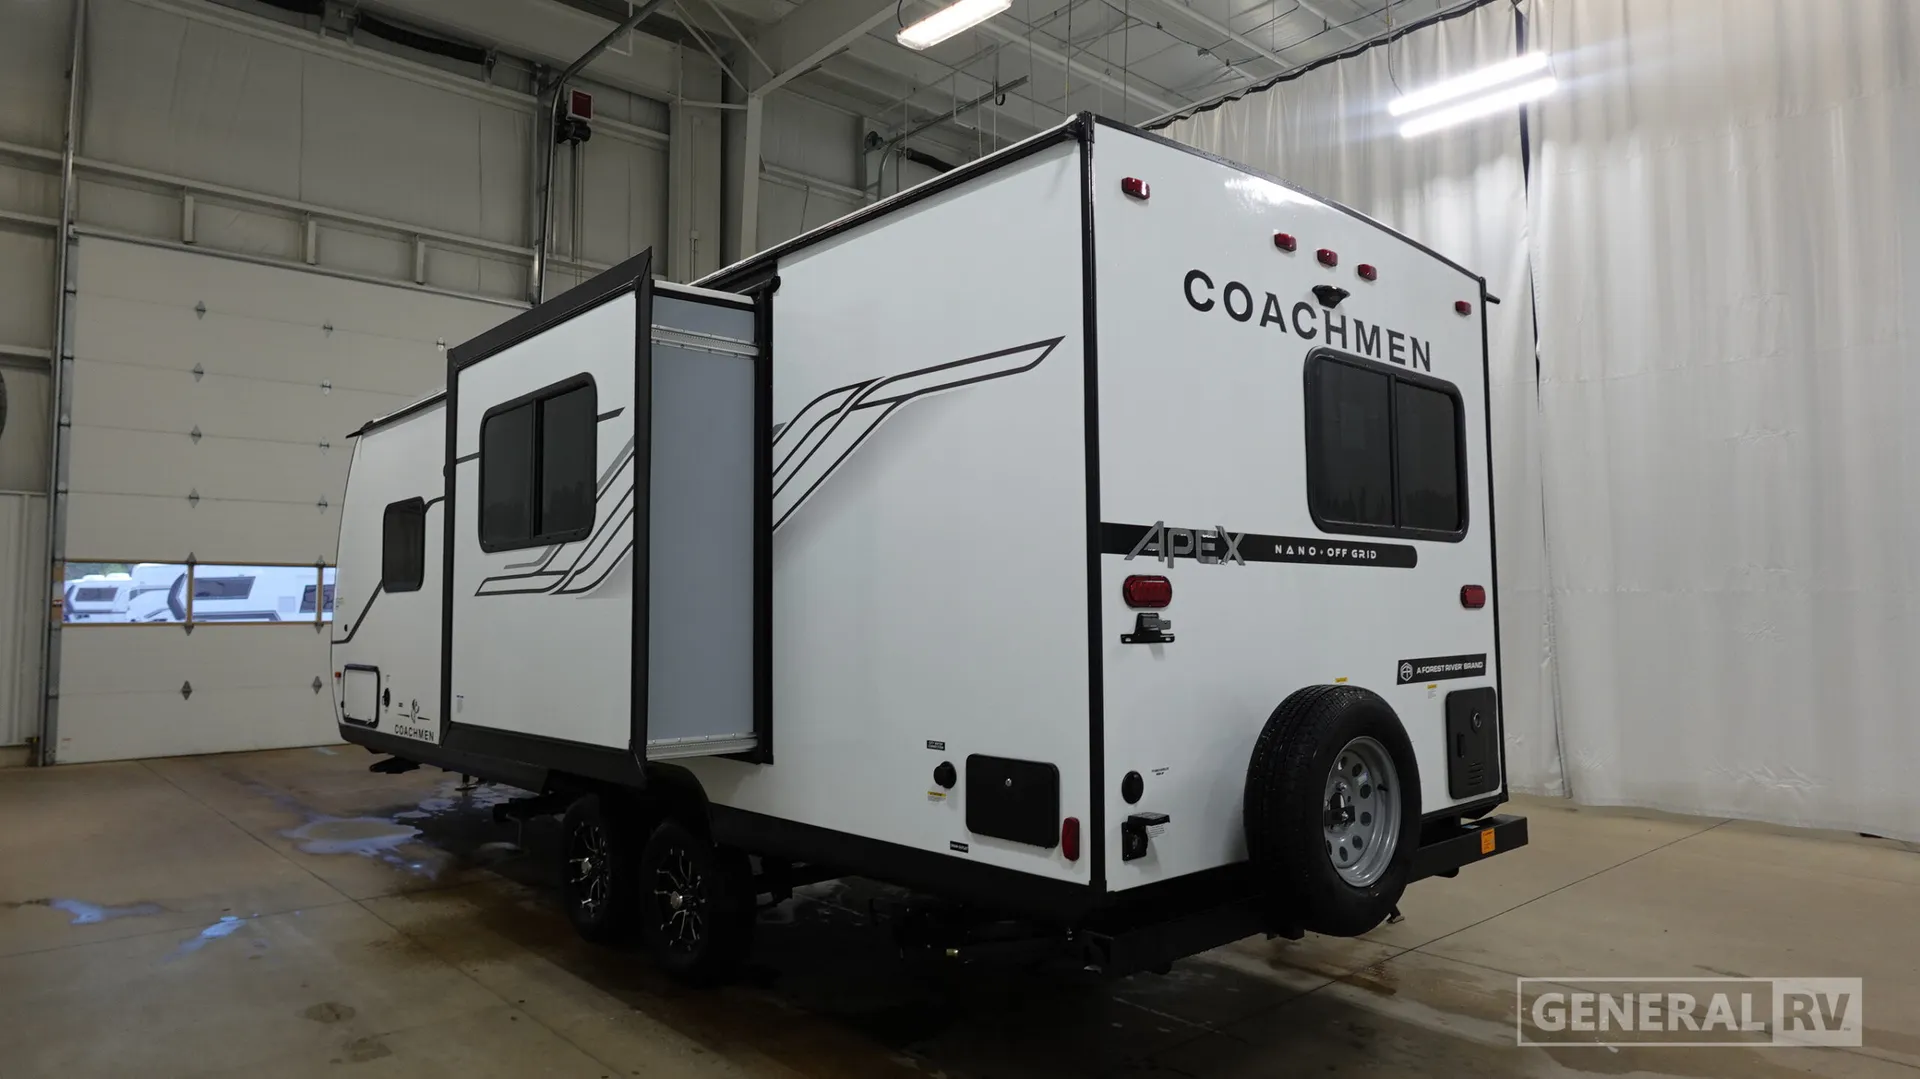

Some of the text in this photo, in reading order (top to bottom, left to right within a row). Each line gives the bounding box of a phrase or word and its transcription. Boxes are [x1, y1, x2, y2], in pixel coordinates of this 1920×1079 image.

[1183, 269, 1432, 373] COACHMEN
[1124, 520, 1246, 569] APEX
[1275, 544, 1377, 560] NANO OFF GRID
[1416, 661, 1484, 675] A FOREST RIVER BRAND
[394, 724, 435, 741] COACHMEN
